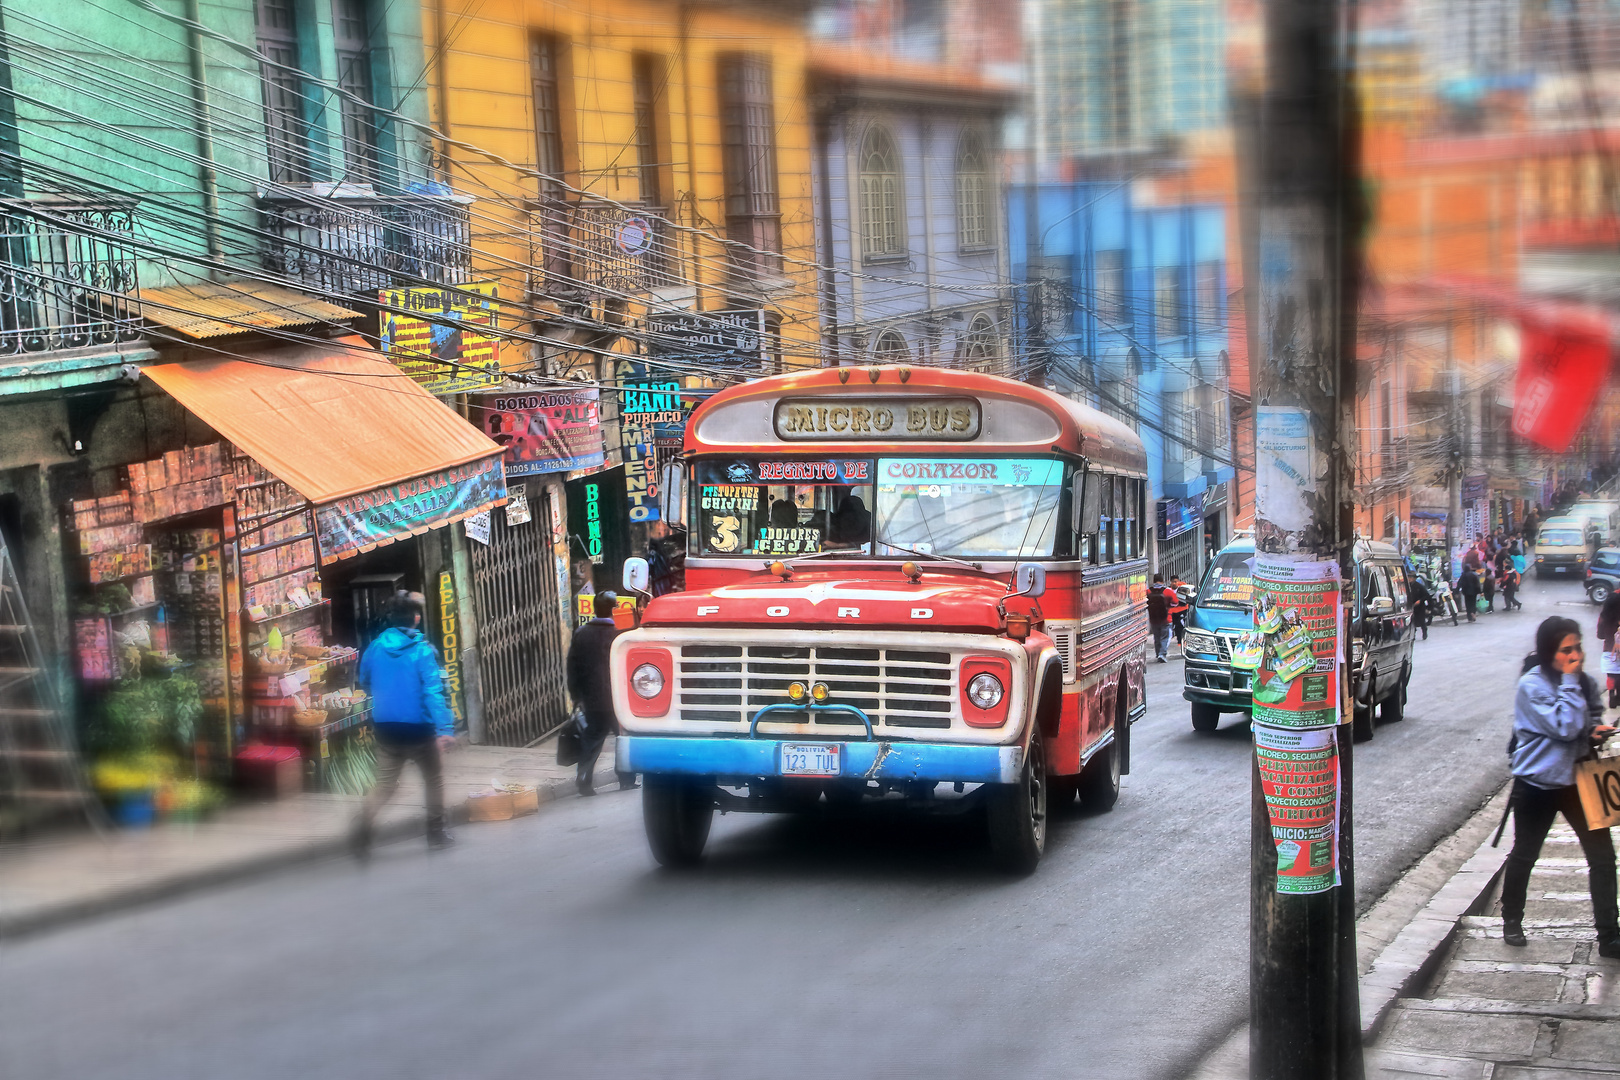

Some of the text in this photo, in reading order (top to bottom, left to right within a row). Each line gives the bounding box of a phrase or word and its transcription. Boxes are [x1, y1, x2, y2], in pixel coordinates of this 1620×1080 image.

[495, 394, 572, 411] BORDADOS
[624, 411, 682, 424] PUBLICO
[785, 406, 971, 432] MICRO BUS
[531, 461, 542, 471] AL:
[759, 462, 869, 480] NEGRITO DE
[887, 462, 998, 480] CORAZON
[337, 458, 494, 516] TIENDA BUENA SALUD
[701, 497, 758, 511] CHIJINI
[710, 515, 740, 552] 3
[759, 540, 816, 552] CEJA
[1285, 583, 1332, 592] SEGUIMIENTO
[697, 606, 934, 619] FORD
[440, 574, 463, 720] PELUQUERIA
[785, 754, 837, 770] 123 TUL
[1274, 785, 1284, 796] Y
[1272, 826, 1307, 839] INICIO:
